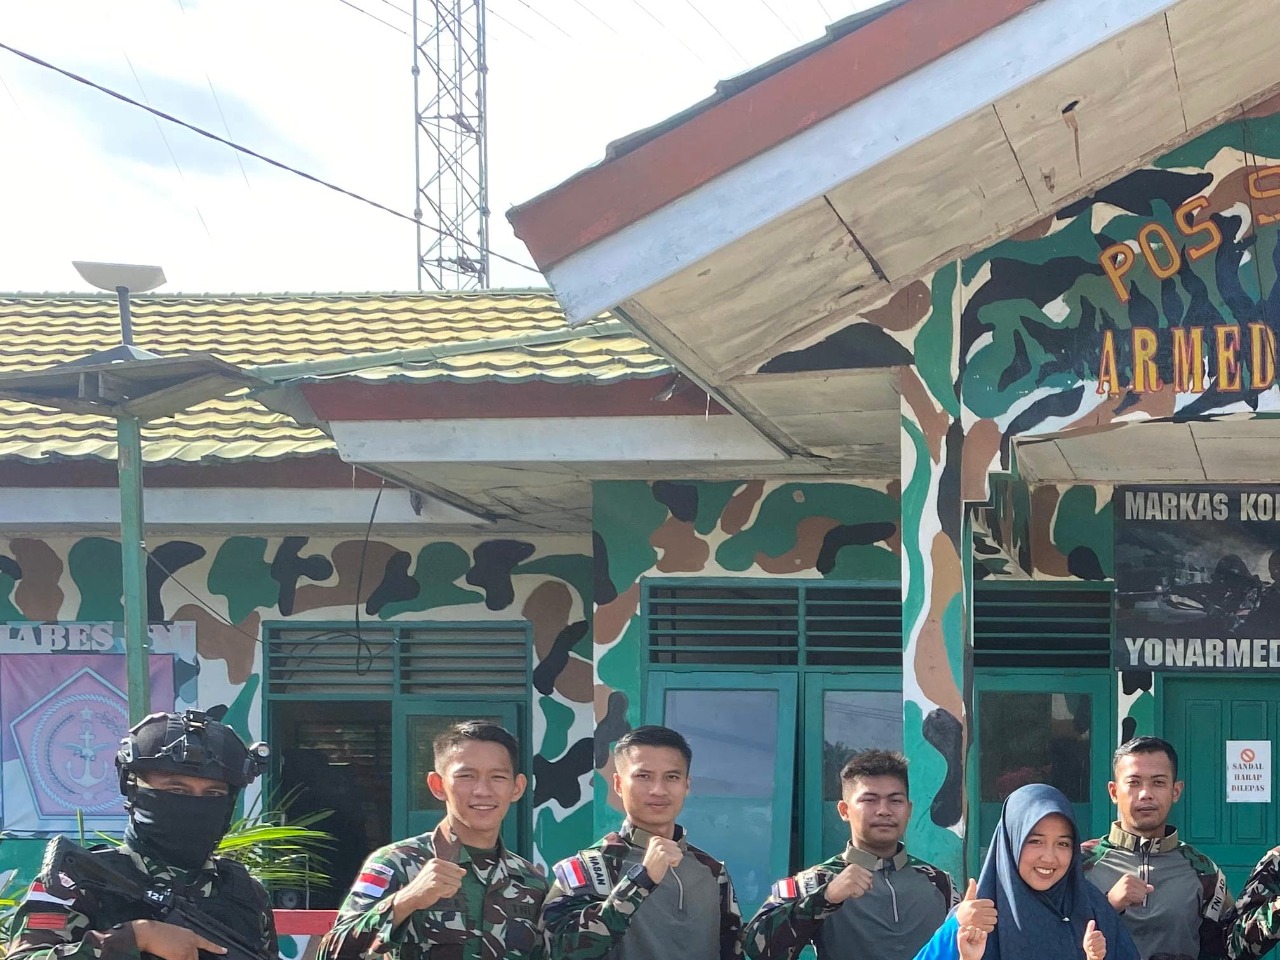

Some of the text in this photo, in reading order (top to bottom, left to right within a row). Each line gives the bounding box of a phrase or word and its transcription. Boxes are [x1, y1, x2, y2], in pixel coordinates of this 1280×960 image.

[1100, 194, 1223, 302] POS
[1096, 320, 1279, 395] ARMED
[1124, 491, 1229, 522] MARKAS
[588, 855, 606, 886] HASAN
[513, 905, 531, 915] TNI
[1211, 895, 1223, 911] TNI
